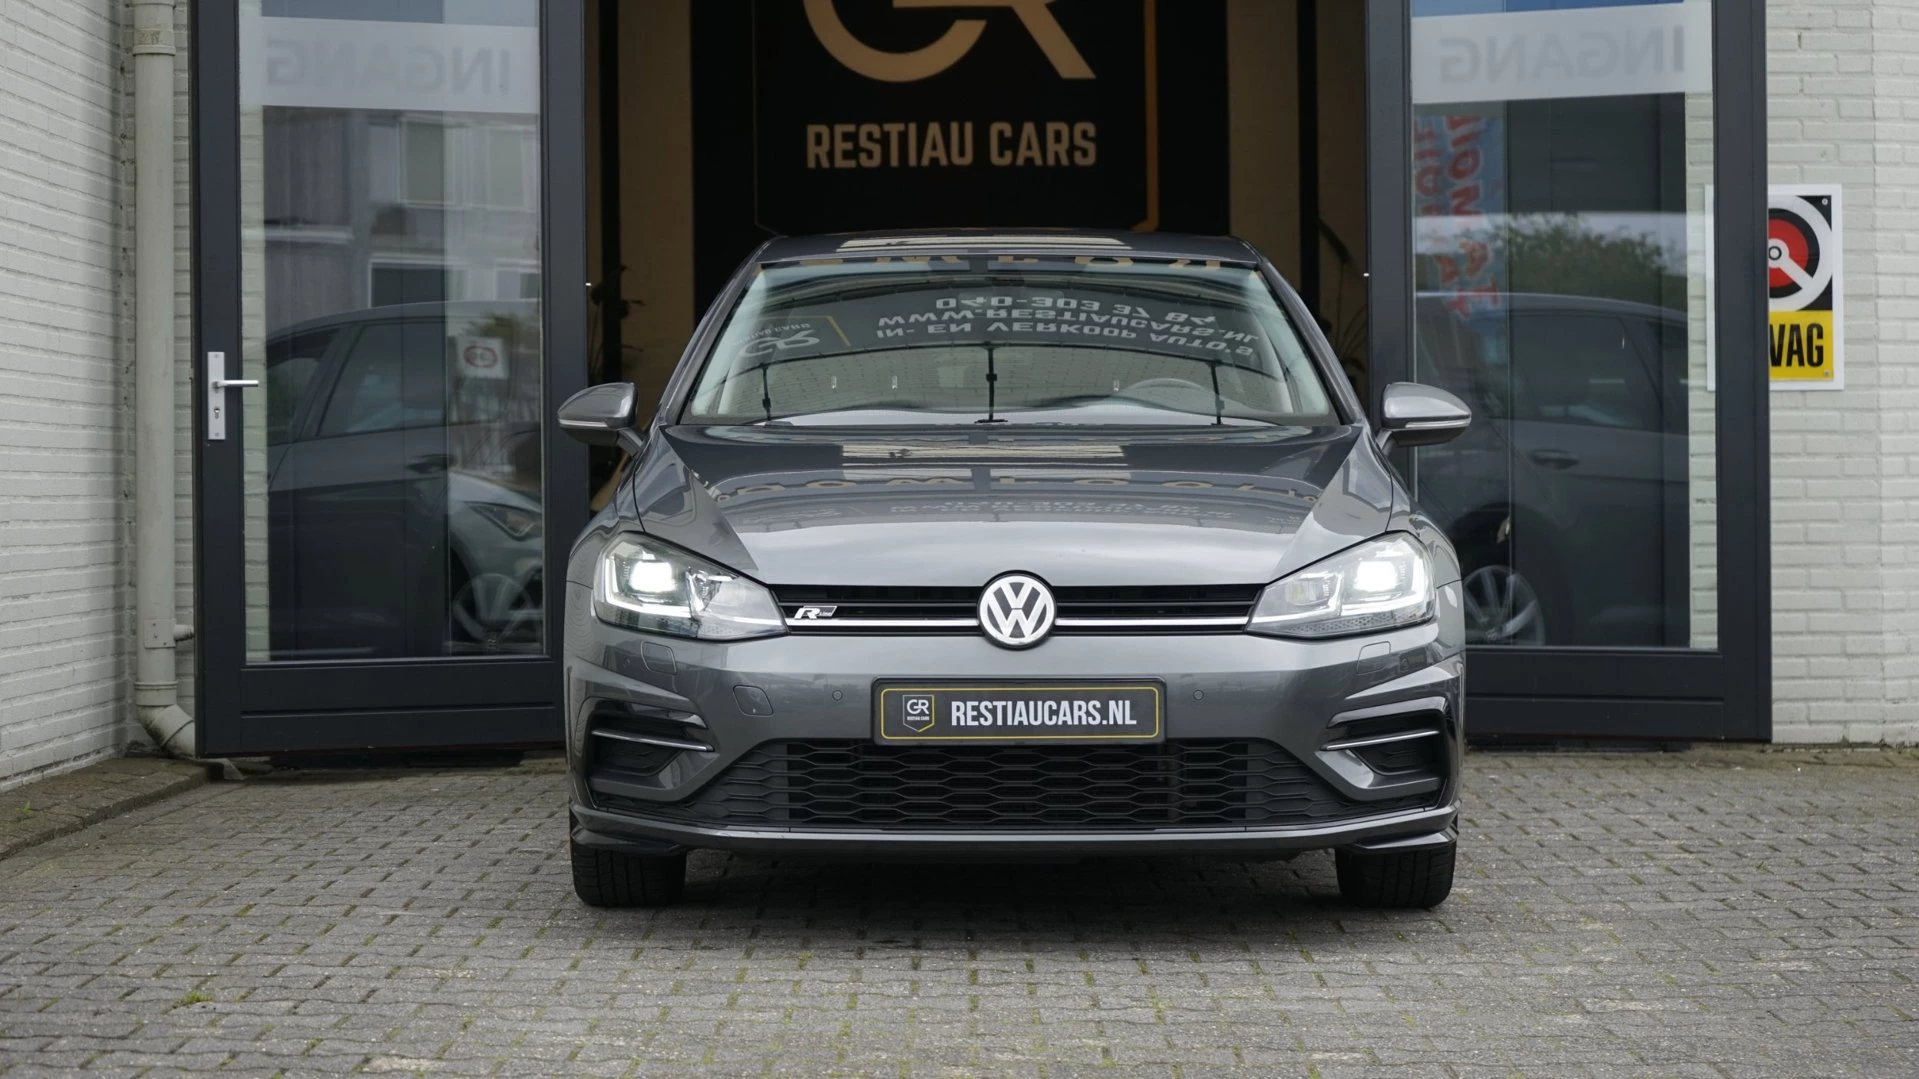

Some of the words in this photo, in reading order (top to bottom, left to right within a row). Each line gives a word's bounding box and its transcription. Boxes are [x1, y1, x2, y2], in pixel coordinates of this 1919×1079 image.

[807, 122, 973, 169] RESTIAU
[989, 121, 1097, 167] CARS
[1769, 323, 1824, 368] VAG
[907, 699, 930, 715] GR
[951, 700, 1137, 726] RESTIAUCARS.NL
